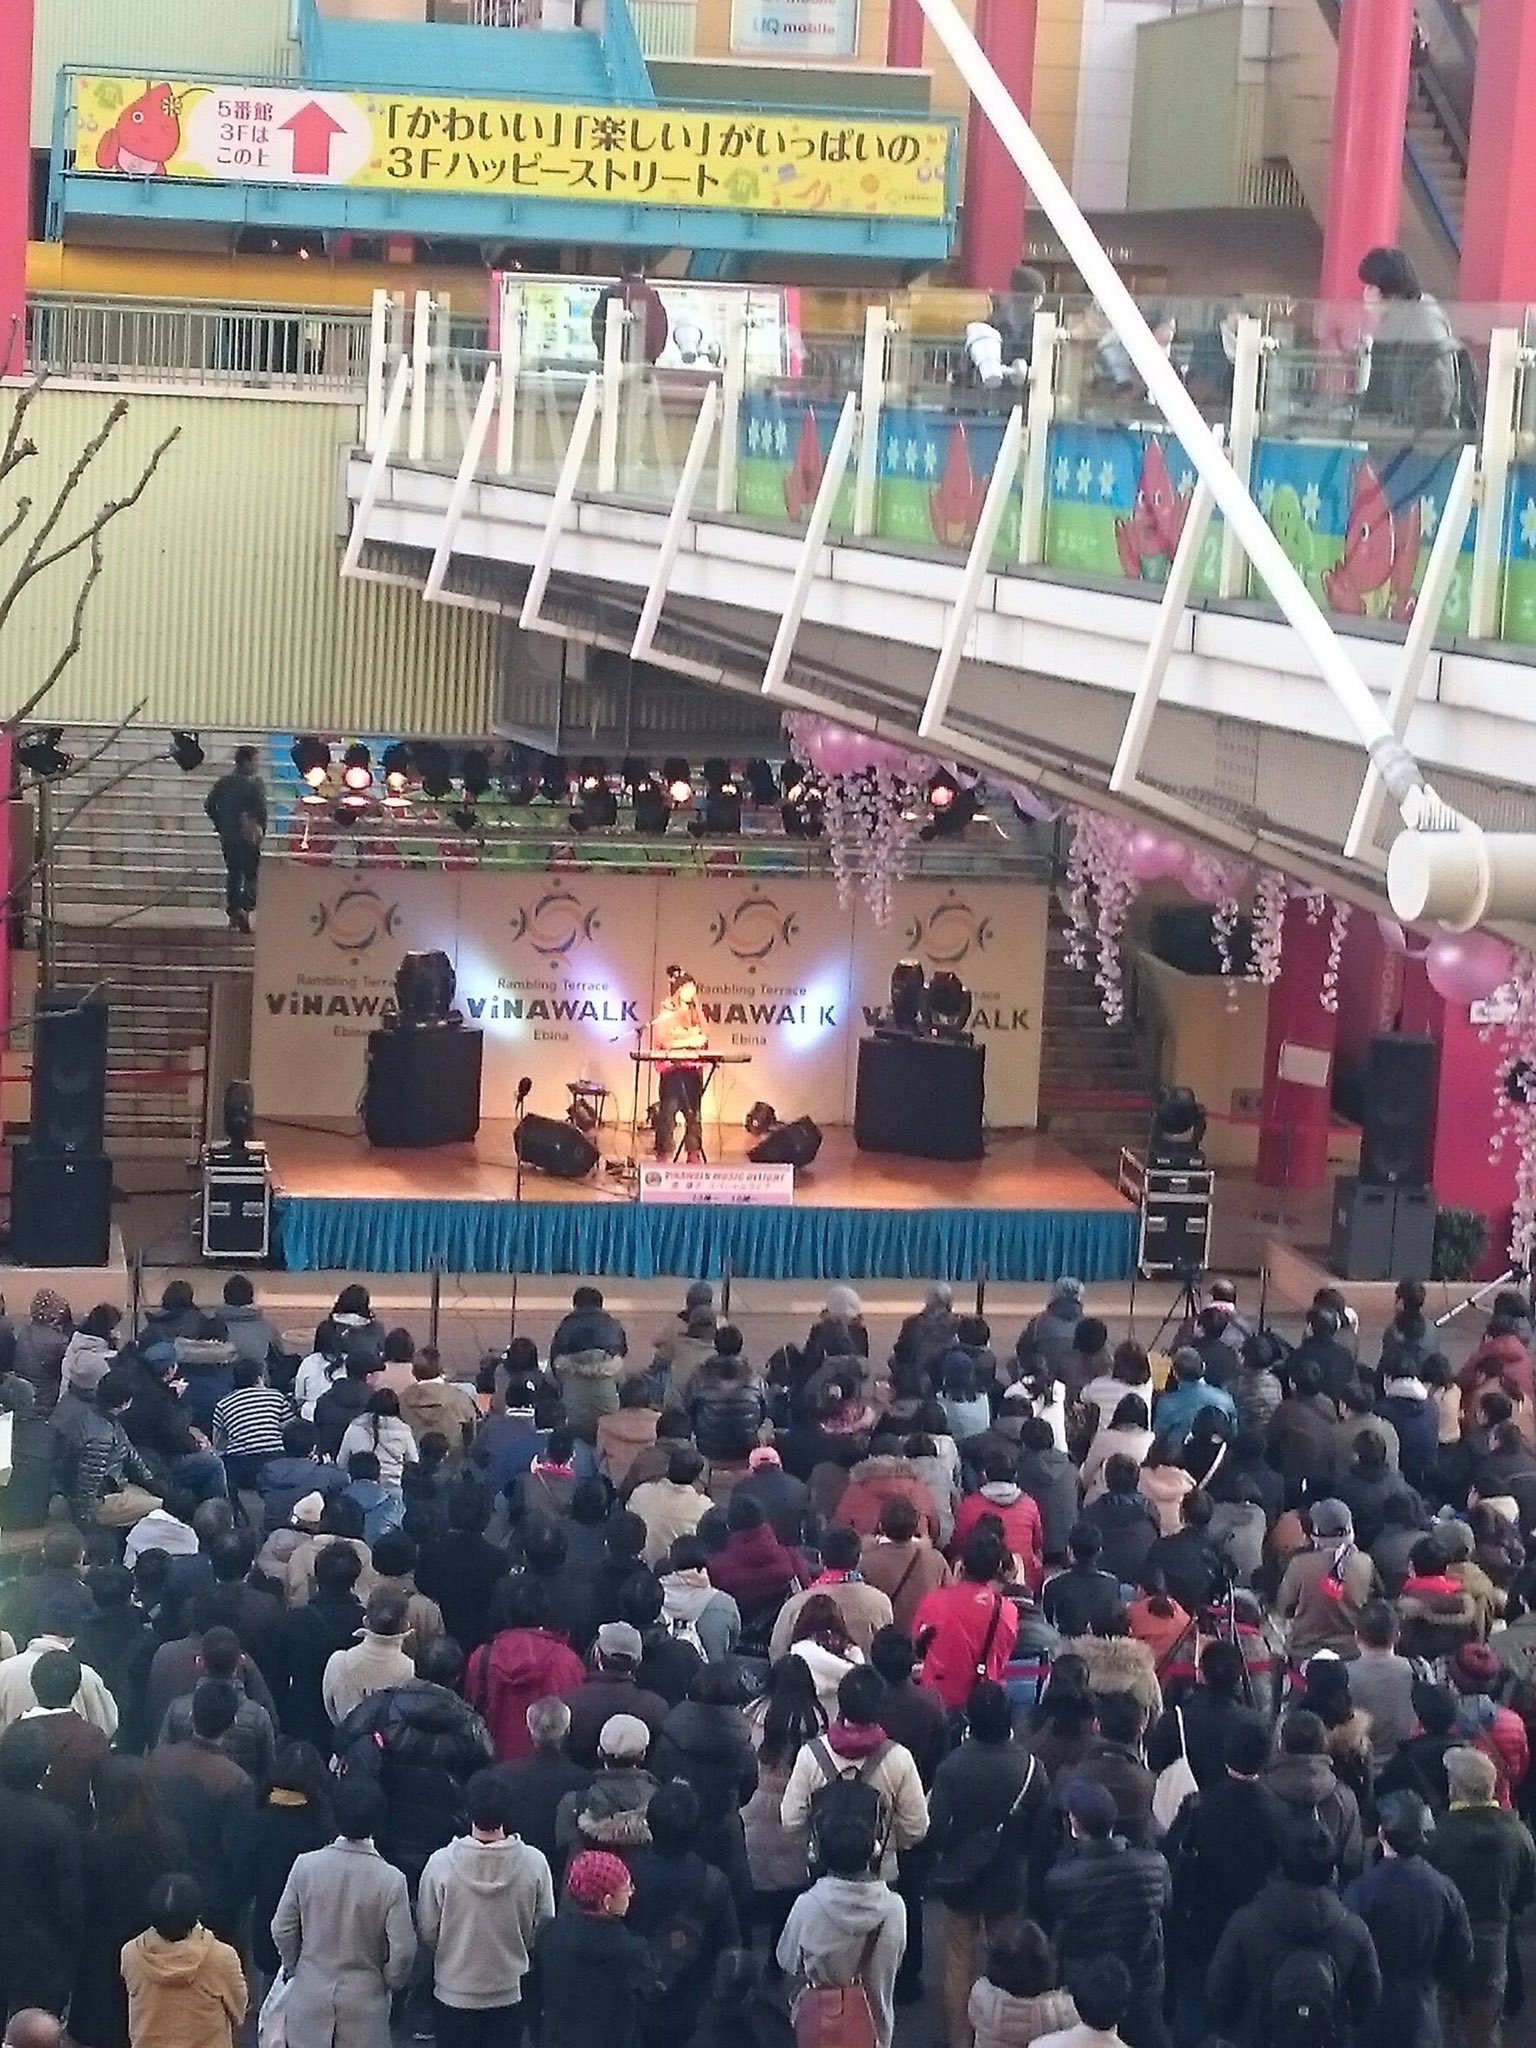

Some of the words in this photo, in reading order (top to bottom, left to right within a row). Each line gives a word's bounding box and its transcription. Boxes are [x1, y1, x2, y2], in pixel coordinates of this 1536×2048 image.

[216, 100, 274, 122] 5番館
[219, 123, 270, 144] 3Fは
[386, 104, 920, 164] 「かわいい」「楽しい」がいっぱいの
[215, 147, 271, 169] この上
[386, 146, 720, 197] 3Fハッピーストリート
[497, 978, 557, 993] Rambling
[563, 980, 609, 991] Terrace
[533, 1029, 570, 1041] Ebina
